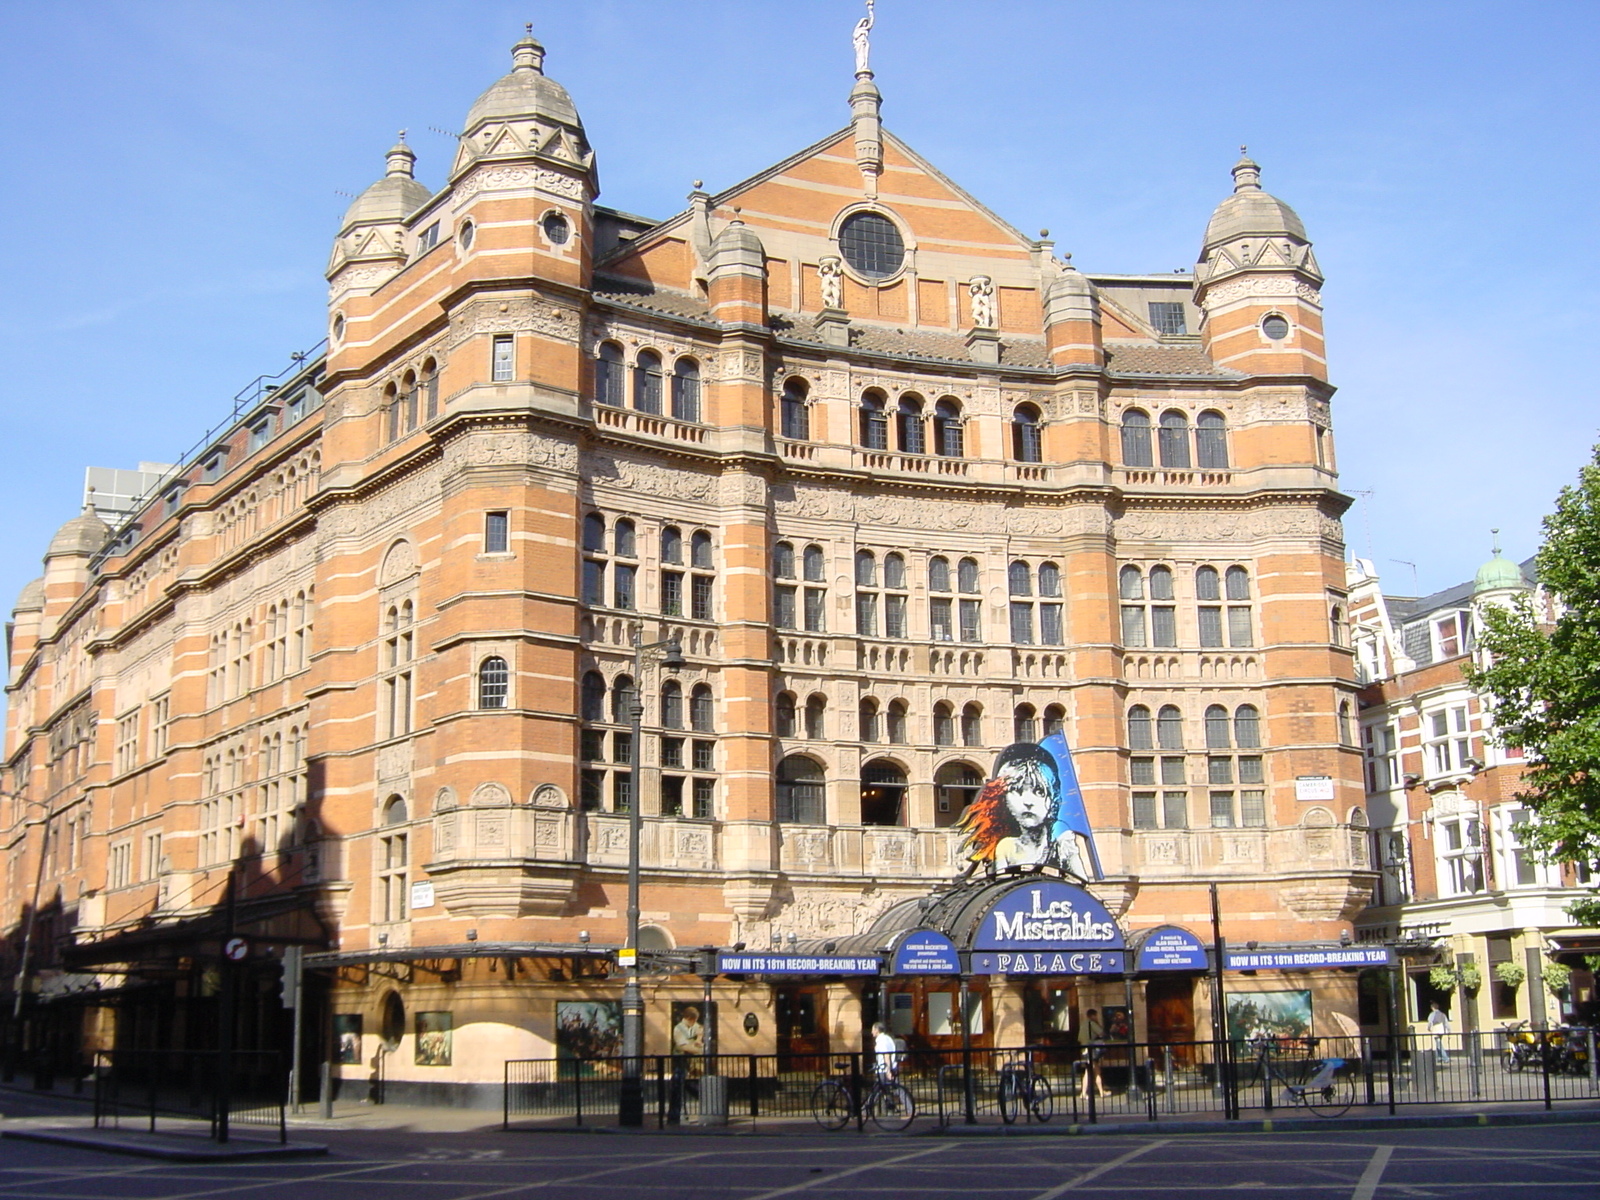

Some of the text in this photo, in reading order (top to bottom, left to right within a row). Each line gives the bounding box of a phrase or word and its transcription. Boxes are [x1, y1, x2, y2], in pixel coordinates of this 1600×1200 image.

[1031, 890, 1072, 918] Les
[994, 911, 1114, 941] Misérables
[1359, 926, 1388, 940] SPICE
[722, 958, 740, 970] NOW
[742, 958, 750, 970] IN
[752, 958, 764, 970] ITS
[786, 959, 856, 970] RECORD-BREAKING
[857, 960, 876, 970] YEAR
[997, 954, 1102, 972] PALACE
[1230, 956, 1248, 966] NOW
[1250, 956, 1258, 966] IN
[1260, 956, 1272, 966] ITS
[1294, 952, 1364, 964] RECORD-BREAKING
[1366, 951, 1386, 961] YEAR
